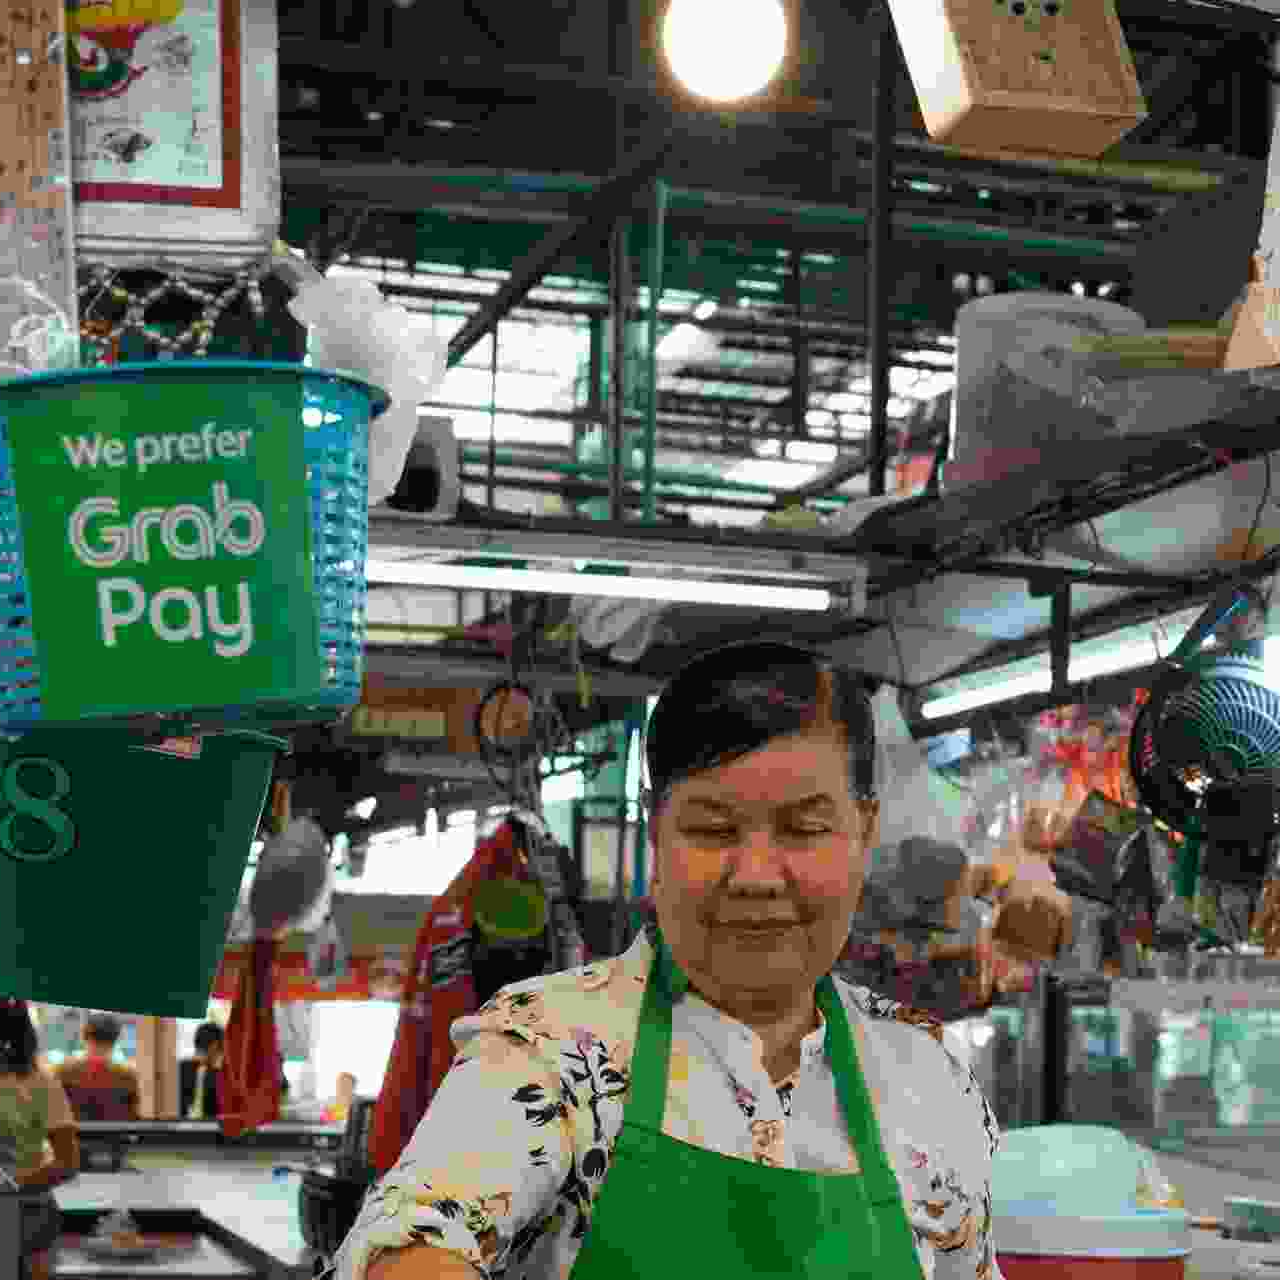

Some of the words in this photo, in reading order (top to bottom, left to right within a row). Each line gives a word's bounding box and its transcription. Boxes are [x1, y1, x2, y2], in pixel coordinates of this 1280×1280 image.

[58, 432, 128, 470] We
[135, 422, 254, 473] prefer
[68, 481, 265, 567] Grab
[96, 577, 254, 657] Pay
